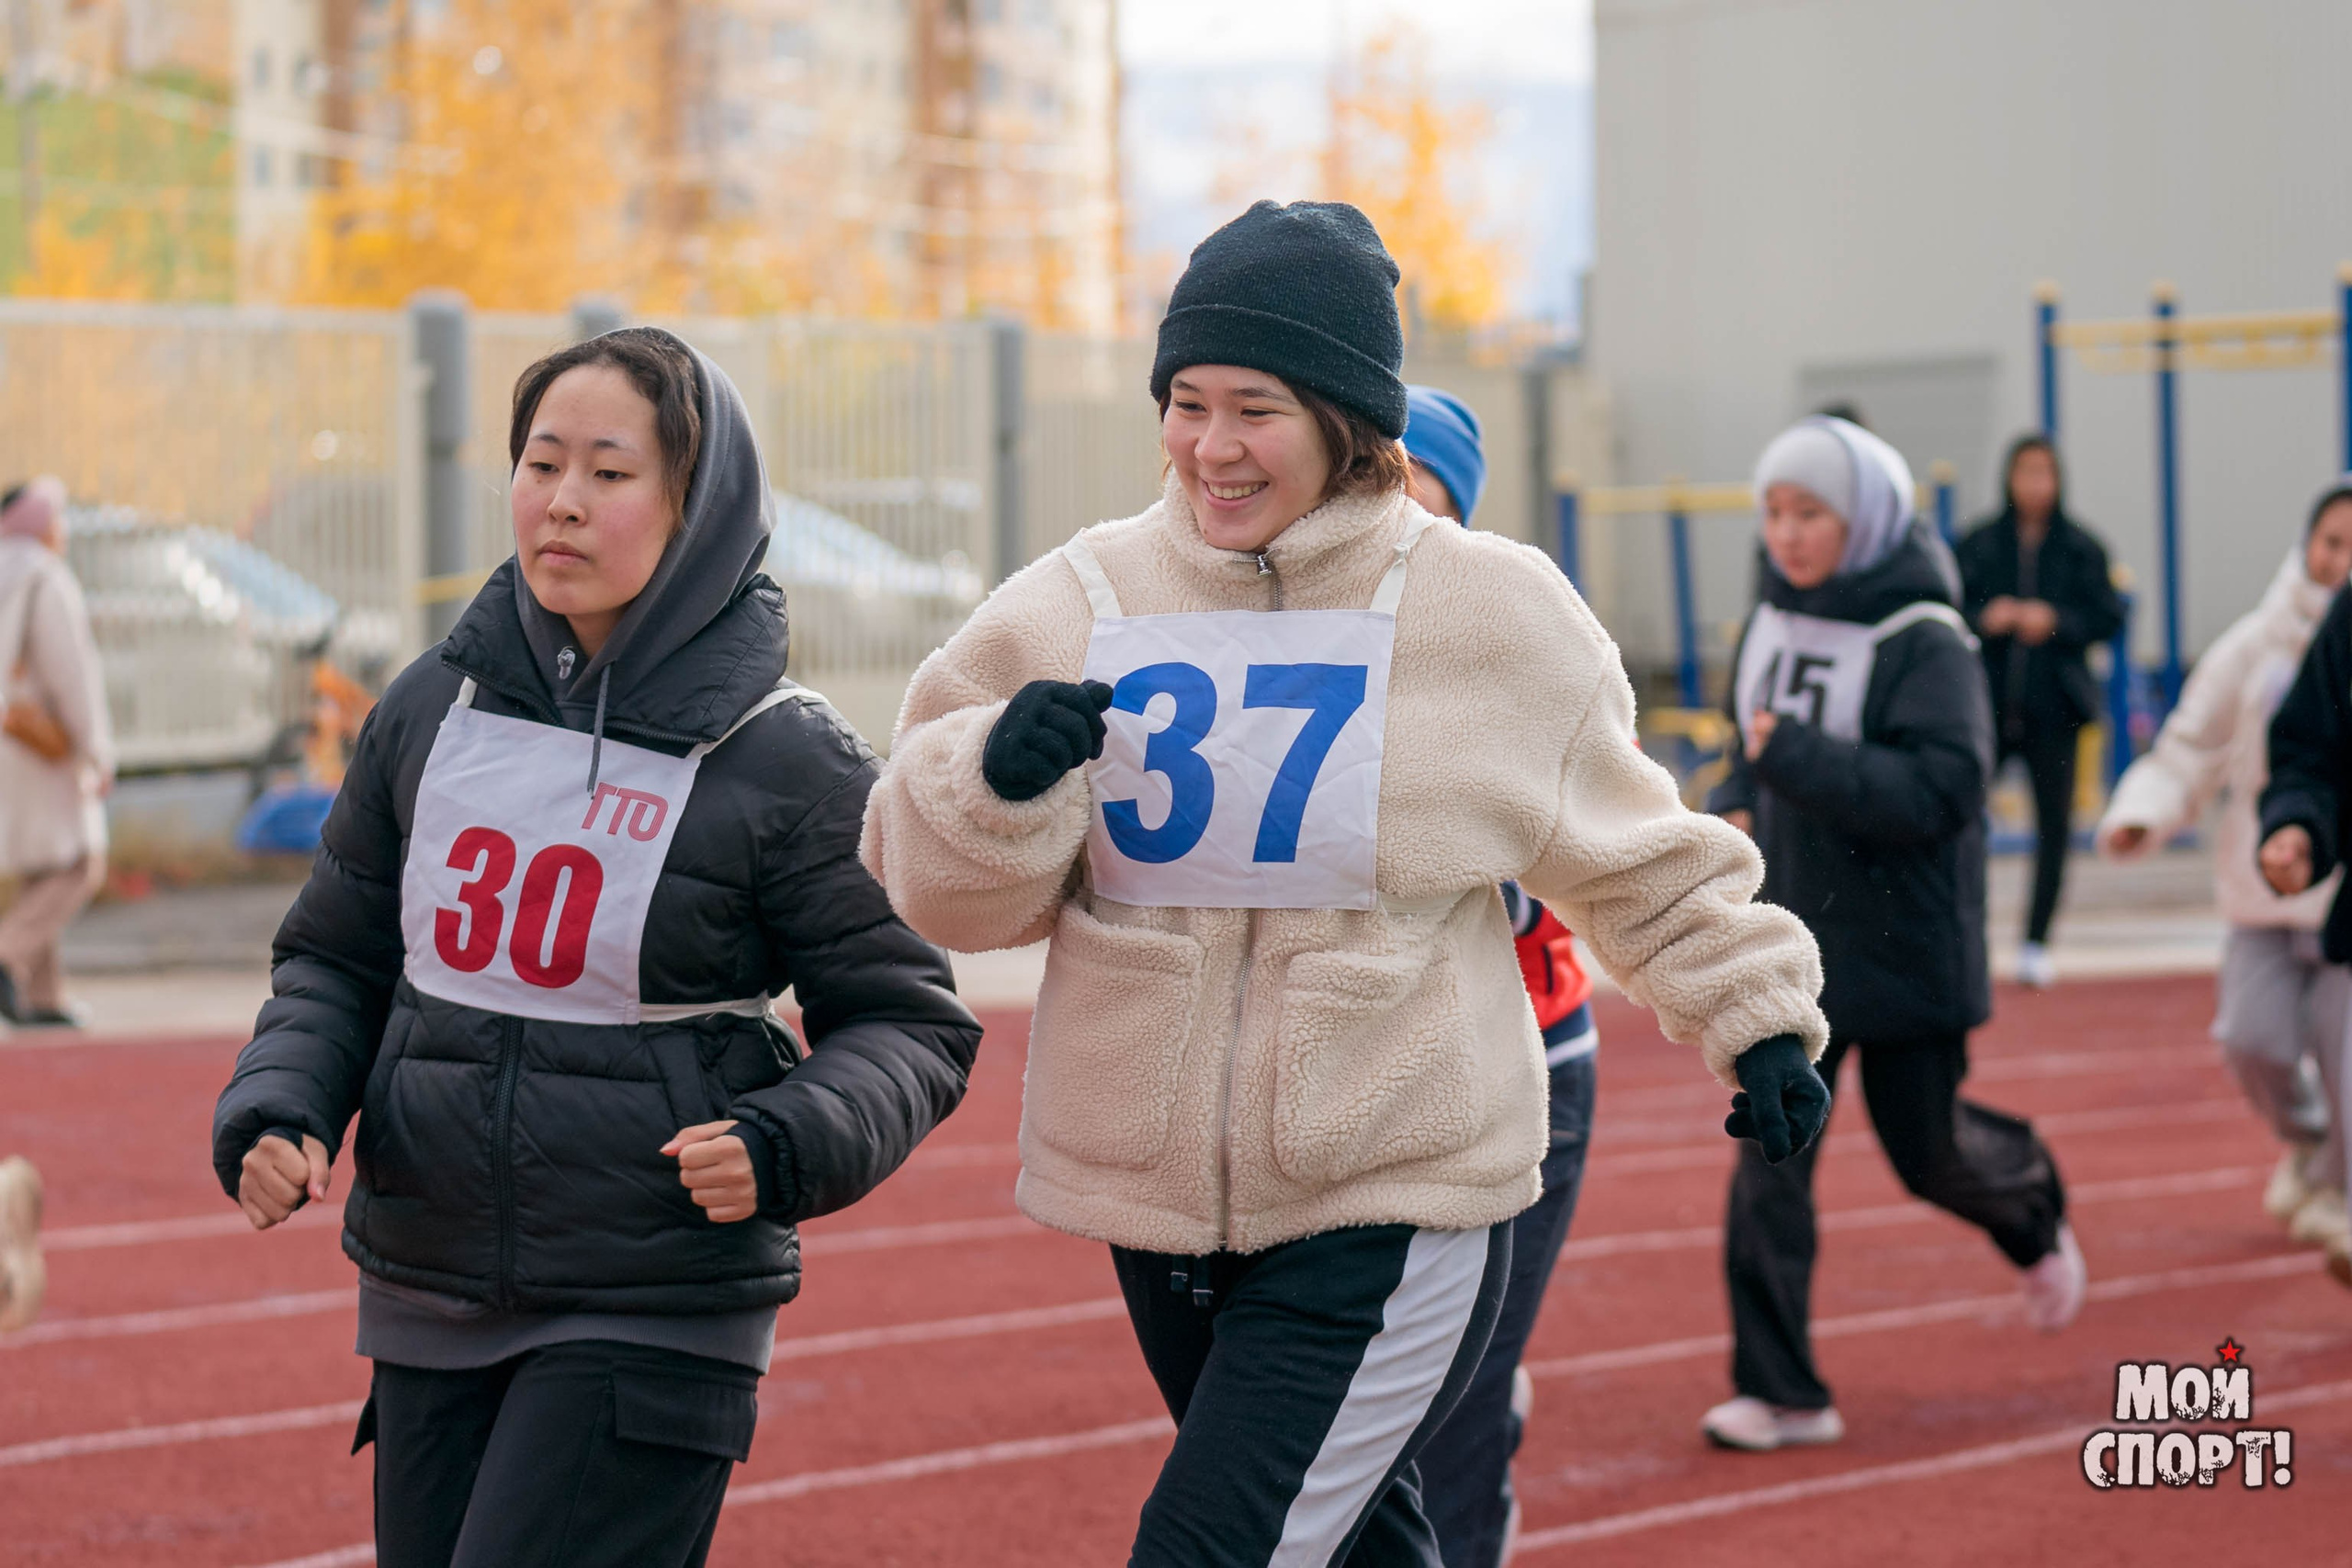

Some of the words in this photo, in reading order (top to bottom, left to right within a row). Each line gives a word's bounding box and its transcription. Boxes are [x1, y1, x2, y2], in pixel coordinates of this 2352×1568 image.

[582, 783, 669, 841] ГТО
[1102, 662, 1368, 863] 37
[434, 826, 604, 988] 30
